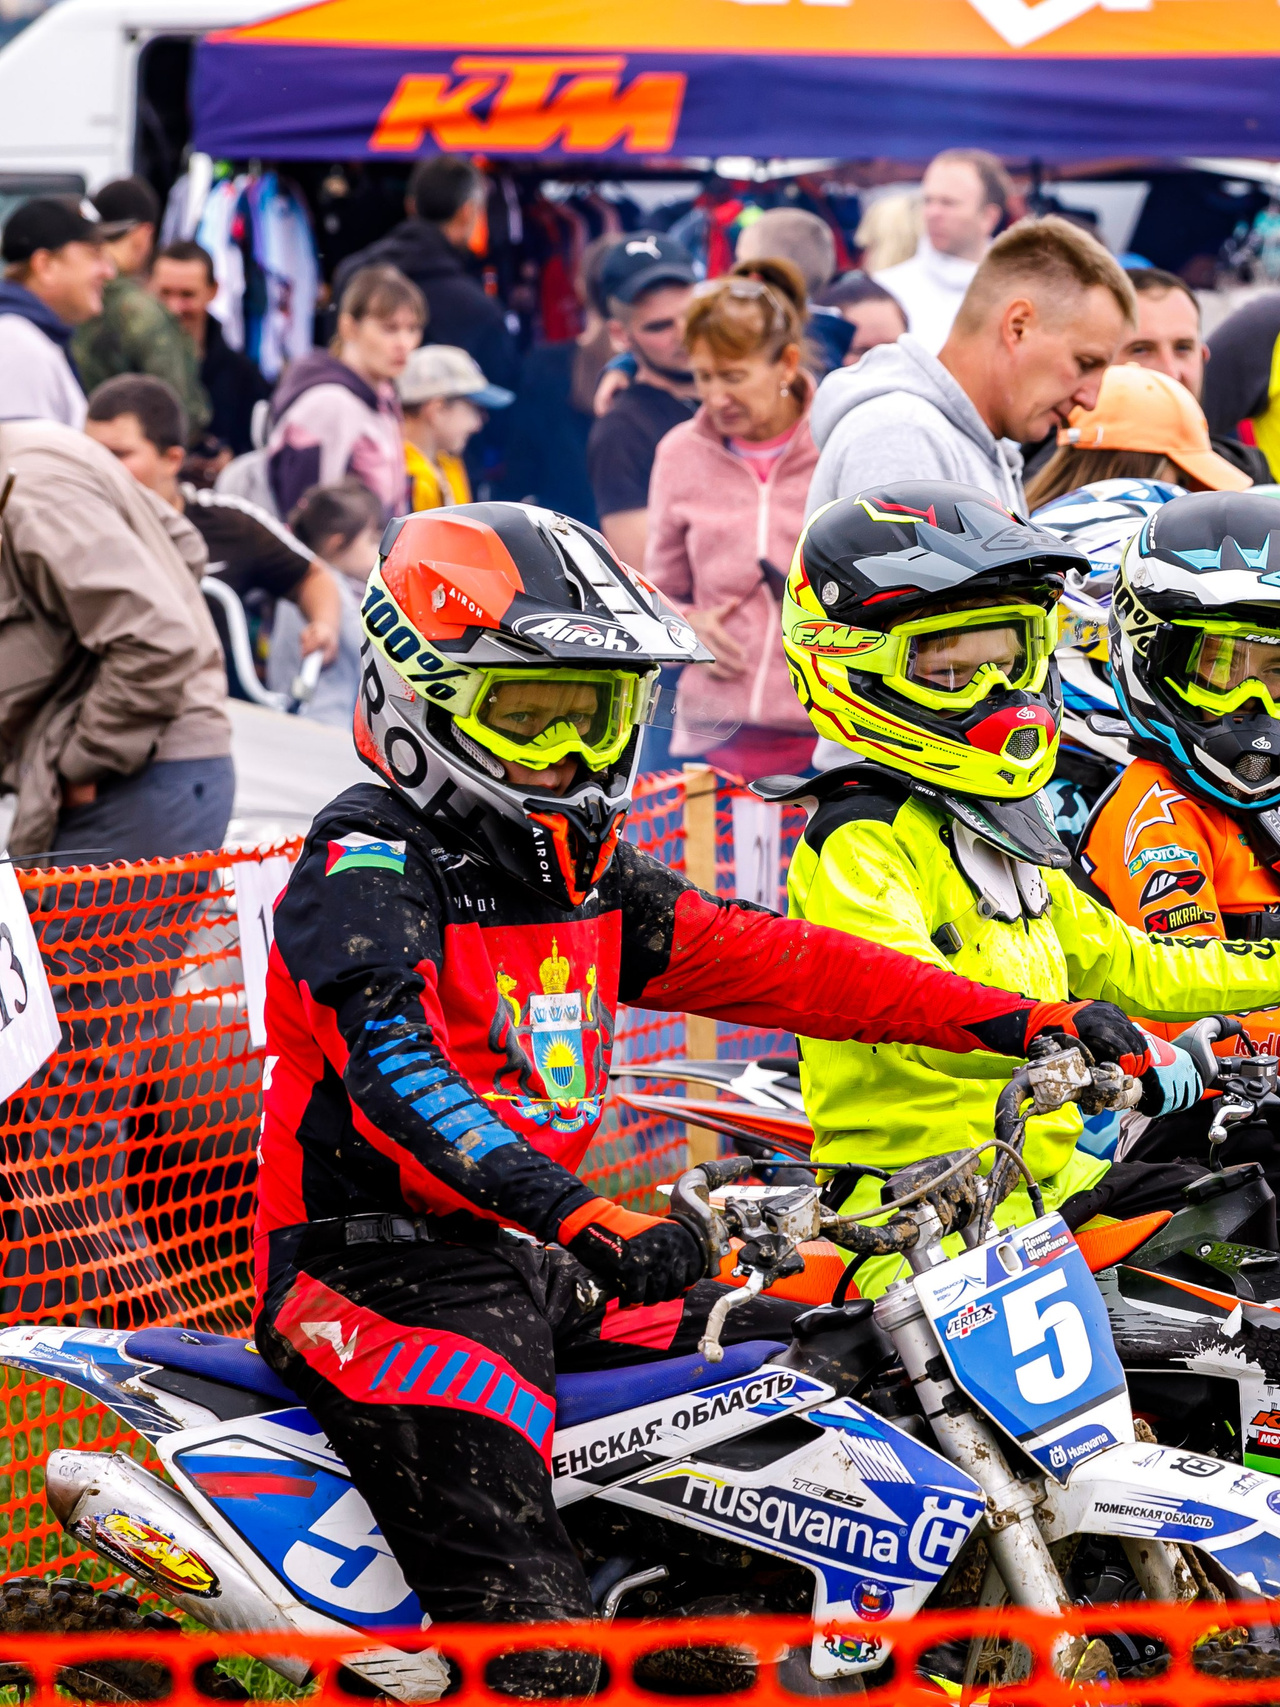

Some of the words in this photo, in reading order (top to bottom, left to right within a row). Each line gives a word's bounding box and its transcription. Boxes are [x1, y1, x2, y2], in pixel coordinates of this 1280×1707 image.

[368, 55, 688, 154] KTM
[449, 587, 483, 619] AIROH
[361, 584, 470, 701] 100%
[524, 617, 628, 652] Airoh
[793, 626, 884, 649] FMF
[532, 826, 552, 883] AIROH
[1023, 1231, 1052, 1250] Денис
[1027, 1235, 1069, 1262] Щербаков
[947, 1304, 994, 1334] VERTEX
[1002, 1268, 1093, 1405] 5
[553, 1418, 662, 1479] ЕНСКАЯ
[671, 1371, 797, 1431] ОБЛАСТЬ
[1067, 1431, 1109, 1460] Husqvarna
[791, 1475, 868, 1509] TC65
[681, 1474, 900, 1565] Husqvarna
[1093, 1501, 1162, 1521] ТЮМЕНСКАЯ
[1162, 1510, 1214, 1530] ОБЛАСТЬ
[282, 1487, 416, 1614] 5
